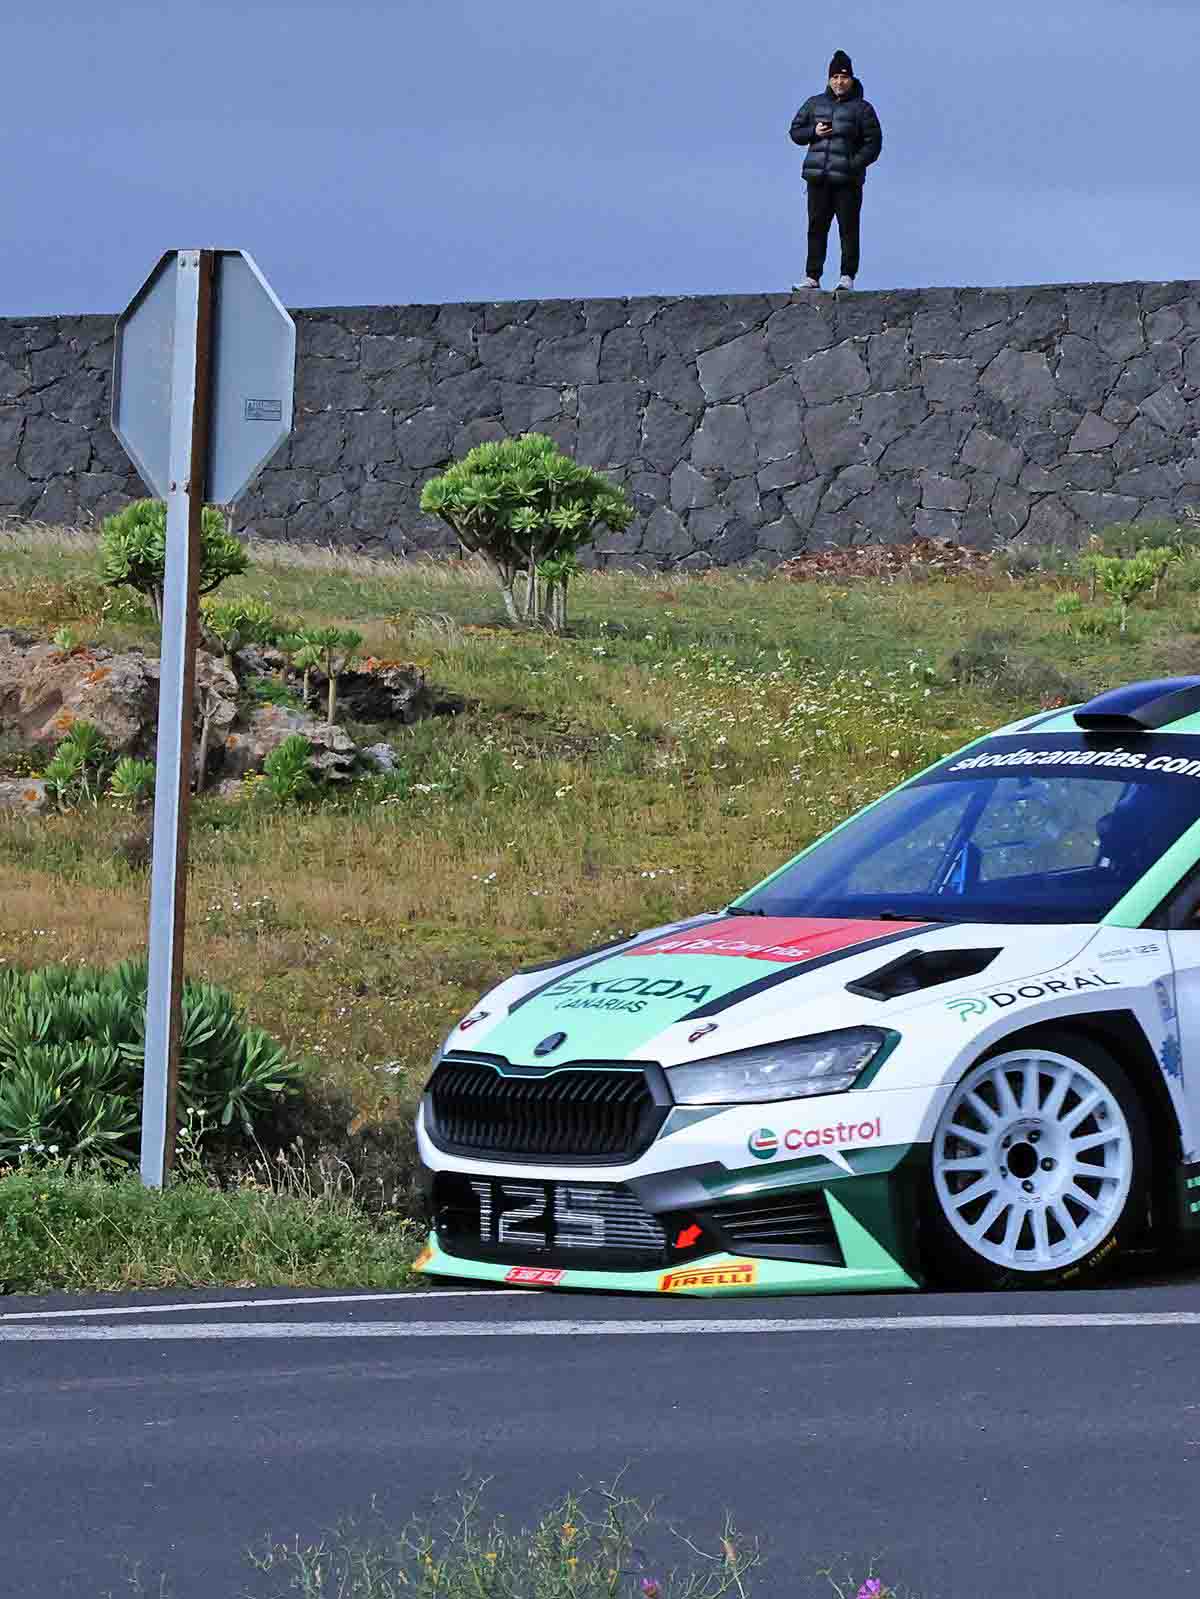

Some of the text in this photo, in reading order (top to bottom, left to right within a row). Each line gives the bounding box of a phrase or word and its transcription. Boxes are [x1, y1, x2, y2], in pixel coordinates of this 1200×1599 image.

[544, 977, 713, 1003] SKODA
[989, 974, 1121, 1007] DORAL
[784, 1117, 881, 1150] Castrol
[660, 1265, 753, 1291] PIRELLI
